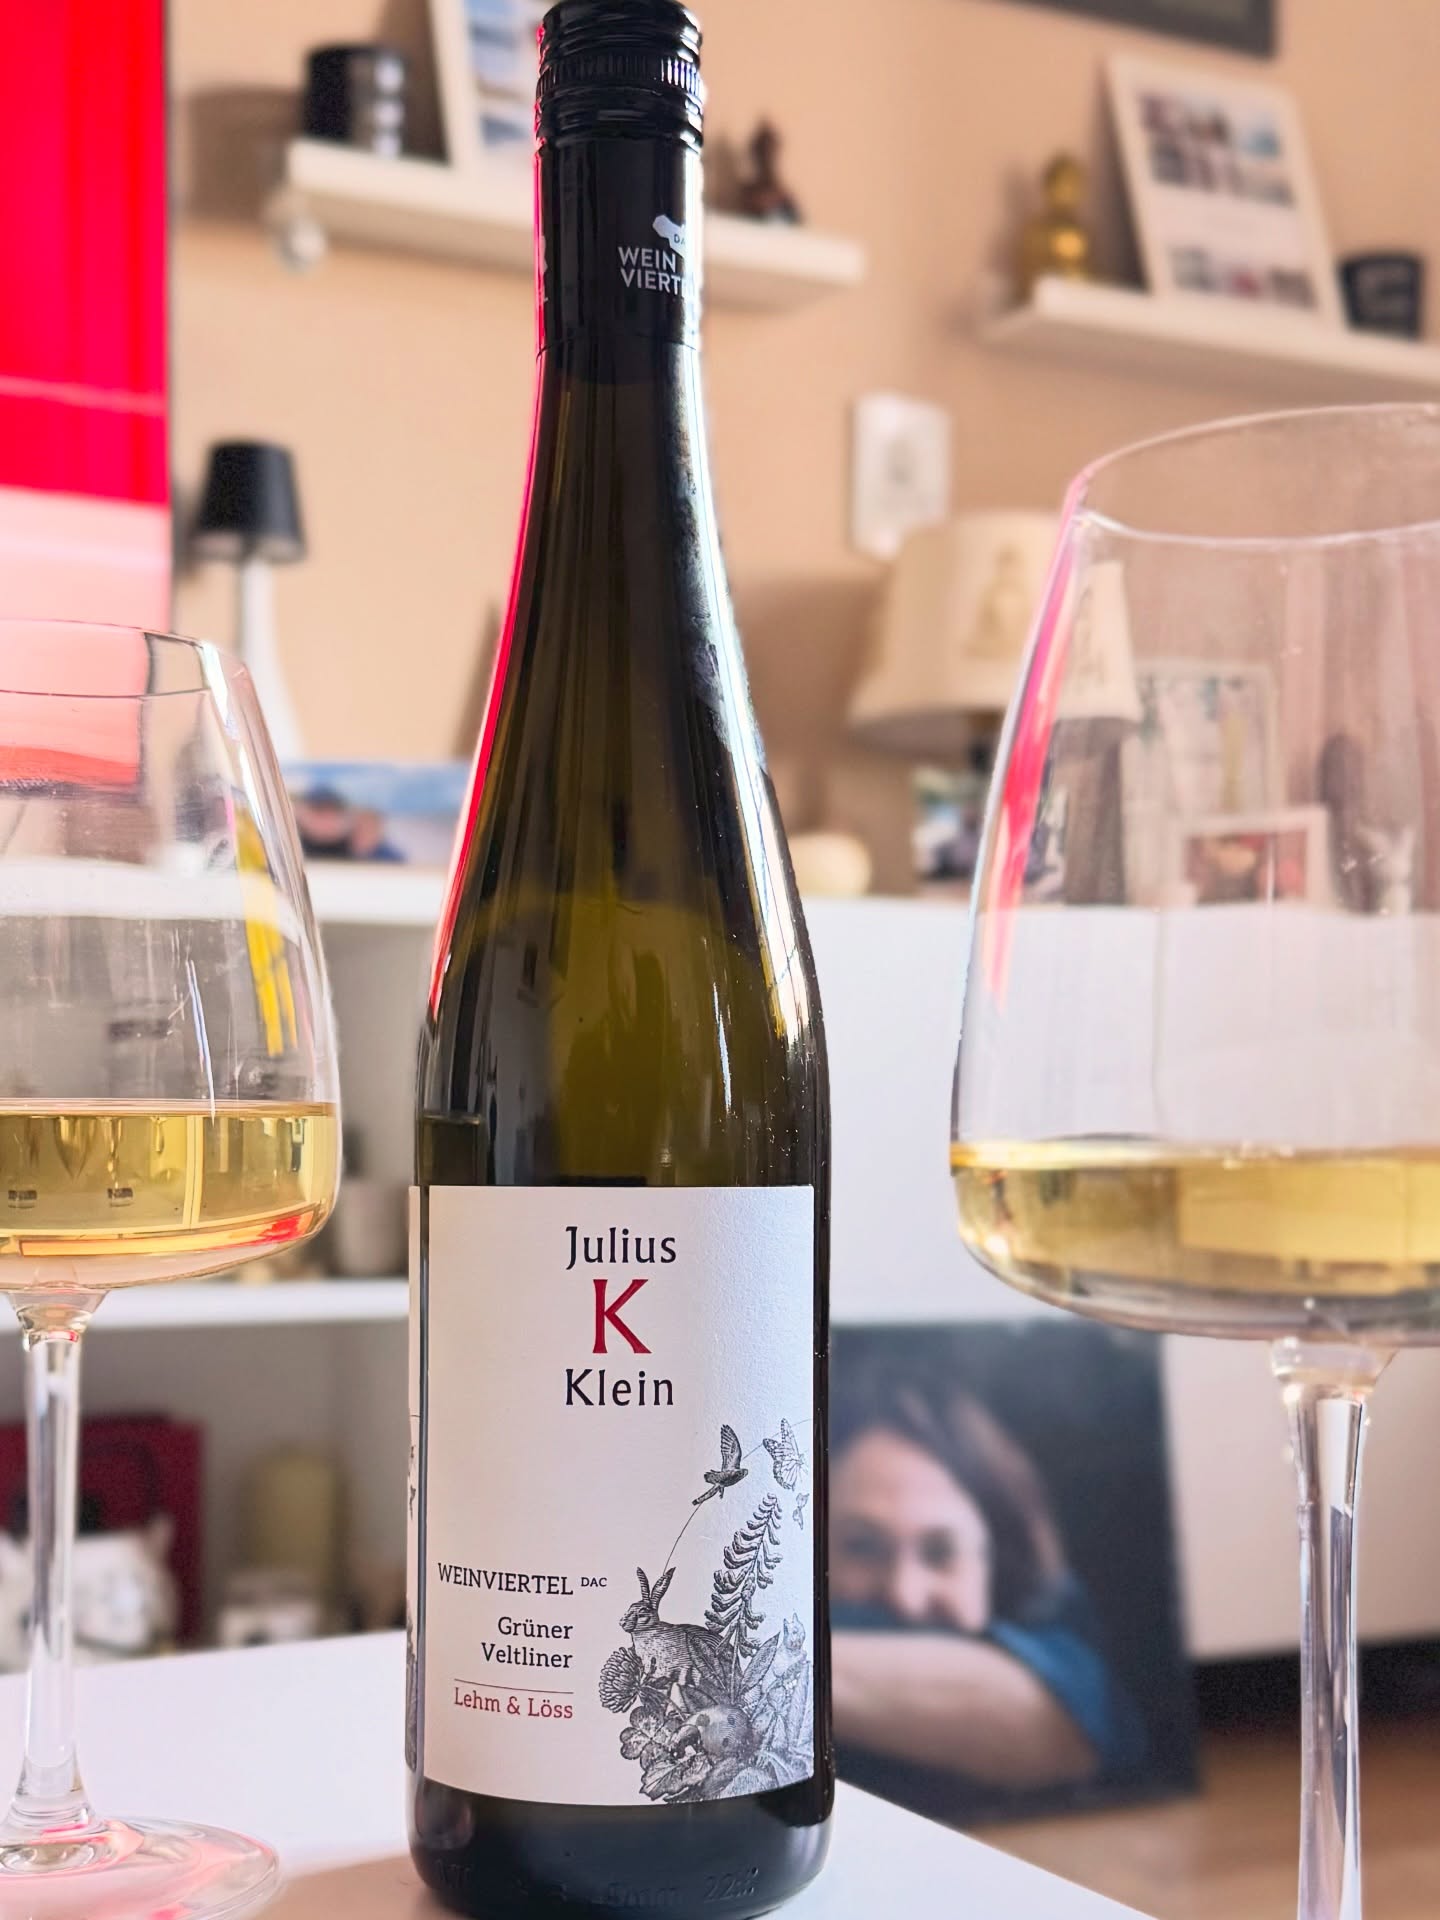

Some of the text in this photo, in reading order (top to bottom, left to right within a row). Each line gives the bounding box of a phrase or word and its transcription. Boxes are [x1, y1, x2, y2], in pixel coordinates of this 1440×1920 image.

[618, 246, 677, 273] WEIN
[565, 1226, 677, 1270] Julius
[592, 1279, 652, 1354] K
[565, 1368, 674, 1406] Klein
[438, 1563, 608, 1595] WEINVIERTEL DAC
[497, 1616, 573, 1639] Grüner
[481, 1642, 573, 1668] Veltliner
[454, 1687, 573, 1719] Lehm & Löss
